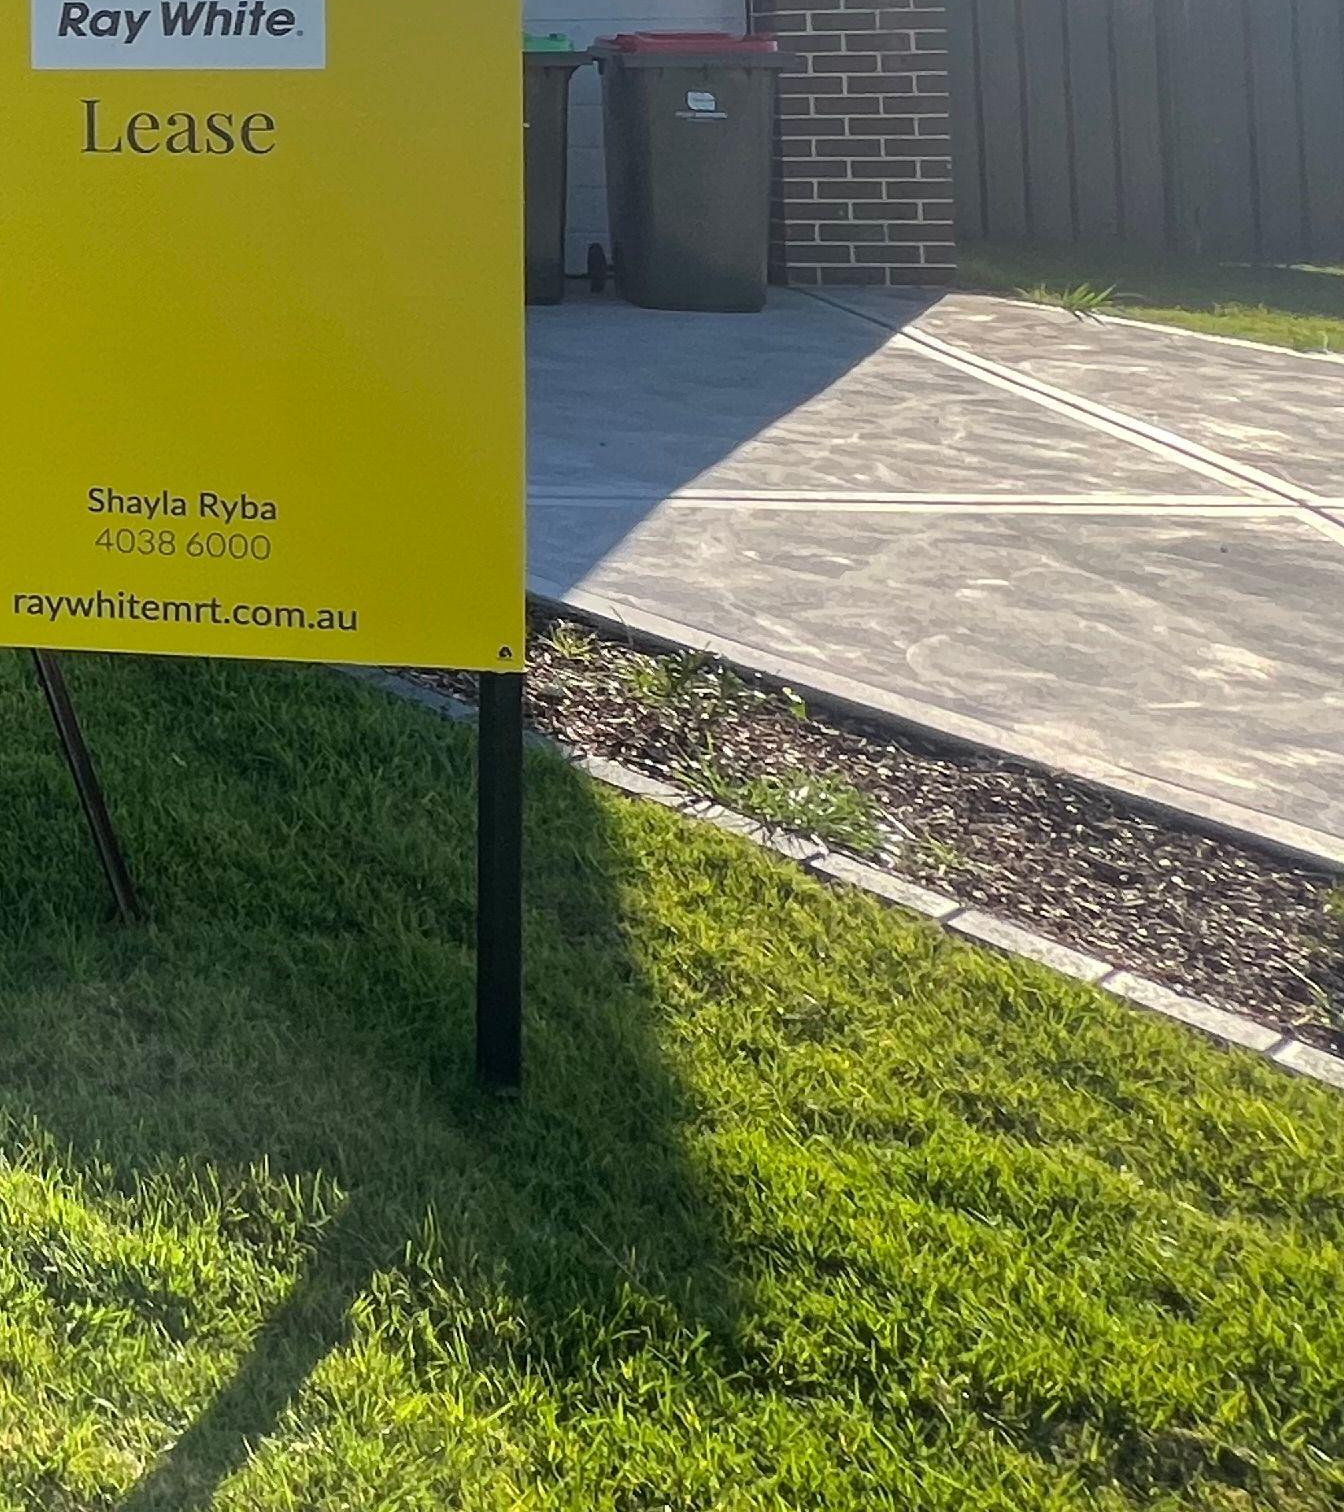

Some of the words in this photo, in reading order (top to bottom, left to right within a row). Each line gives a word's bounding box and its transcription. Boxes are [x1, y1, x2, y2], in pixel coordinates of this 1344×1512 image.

[58, 1, 151, 44] Ray
[80, 99, 276, 155] Lease
[87, 487, 187, 520] Shayla
[199, 492, 277, 525] Ryba
[94, 528, 176, 556] 4038
[186, 532, 272, 561] 6000
[13, 590, 358, 632] raywhitemrt.com.au
